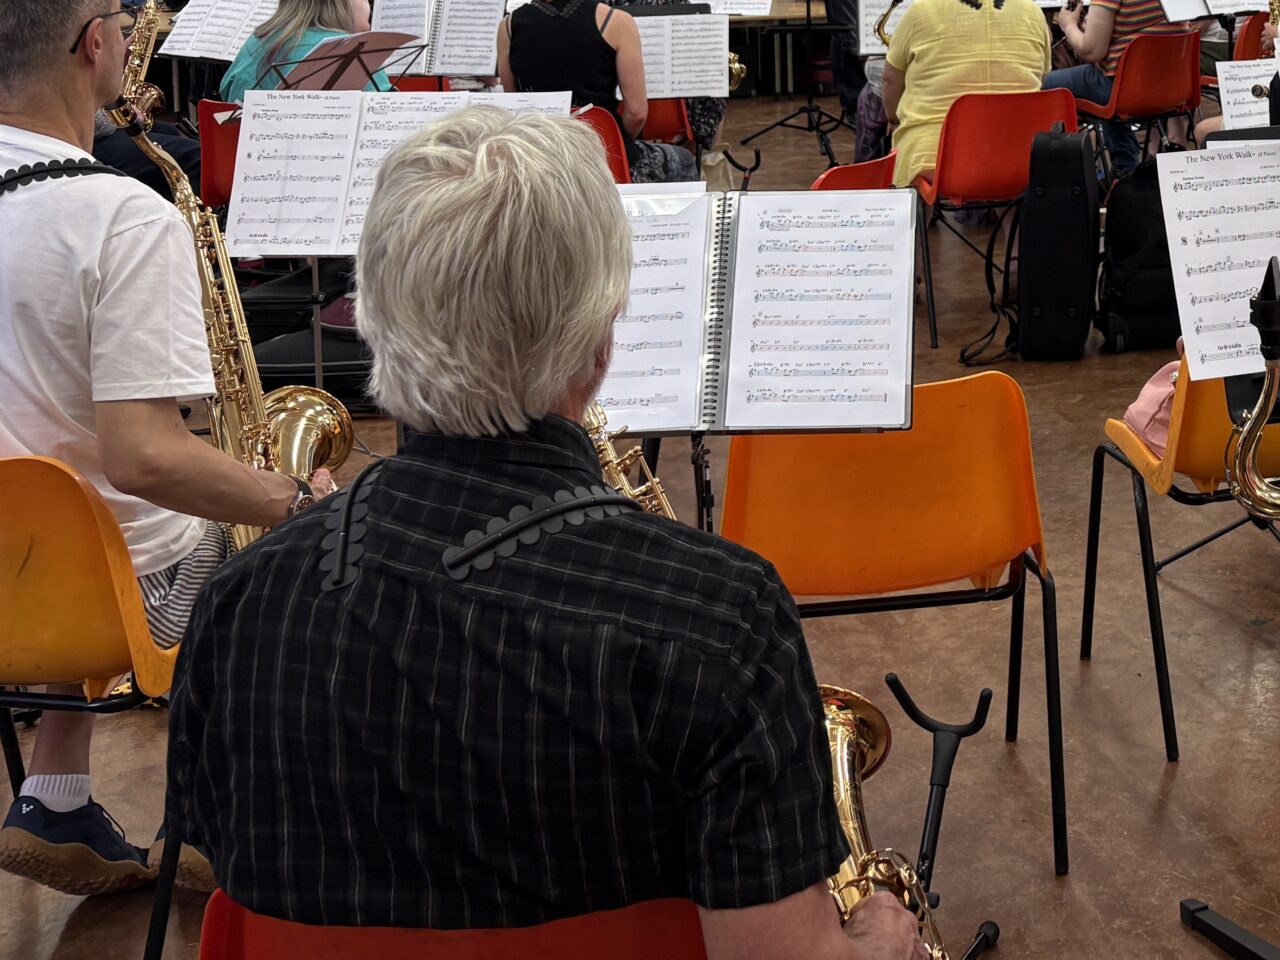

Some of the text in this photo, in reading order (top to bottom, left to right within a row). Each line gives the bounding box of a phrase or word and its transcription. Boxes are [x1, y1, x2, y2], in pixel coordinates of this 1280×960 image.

[1185, 155, 1198, 164] The
[1200, 153, 1215, 163] New
[1217, 152, 1234, 161] York
